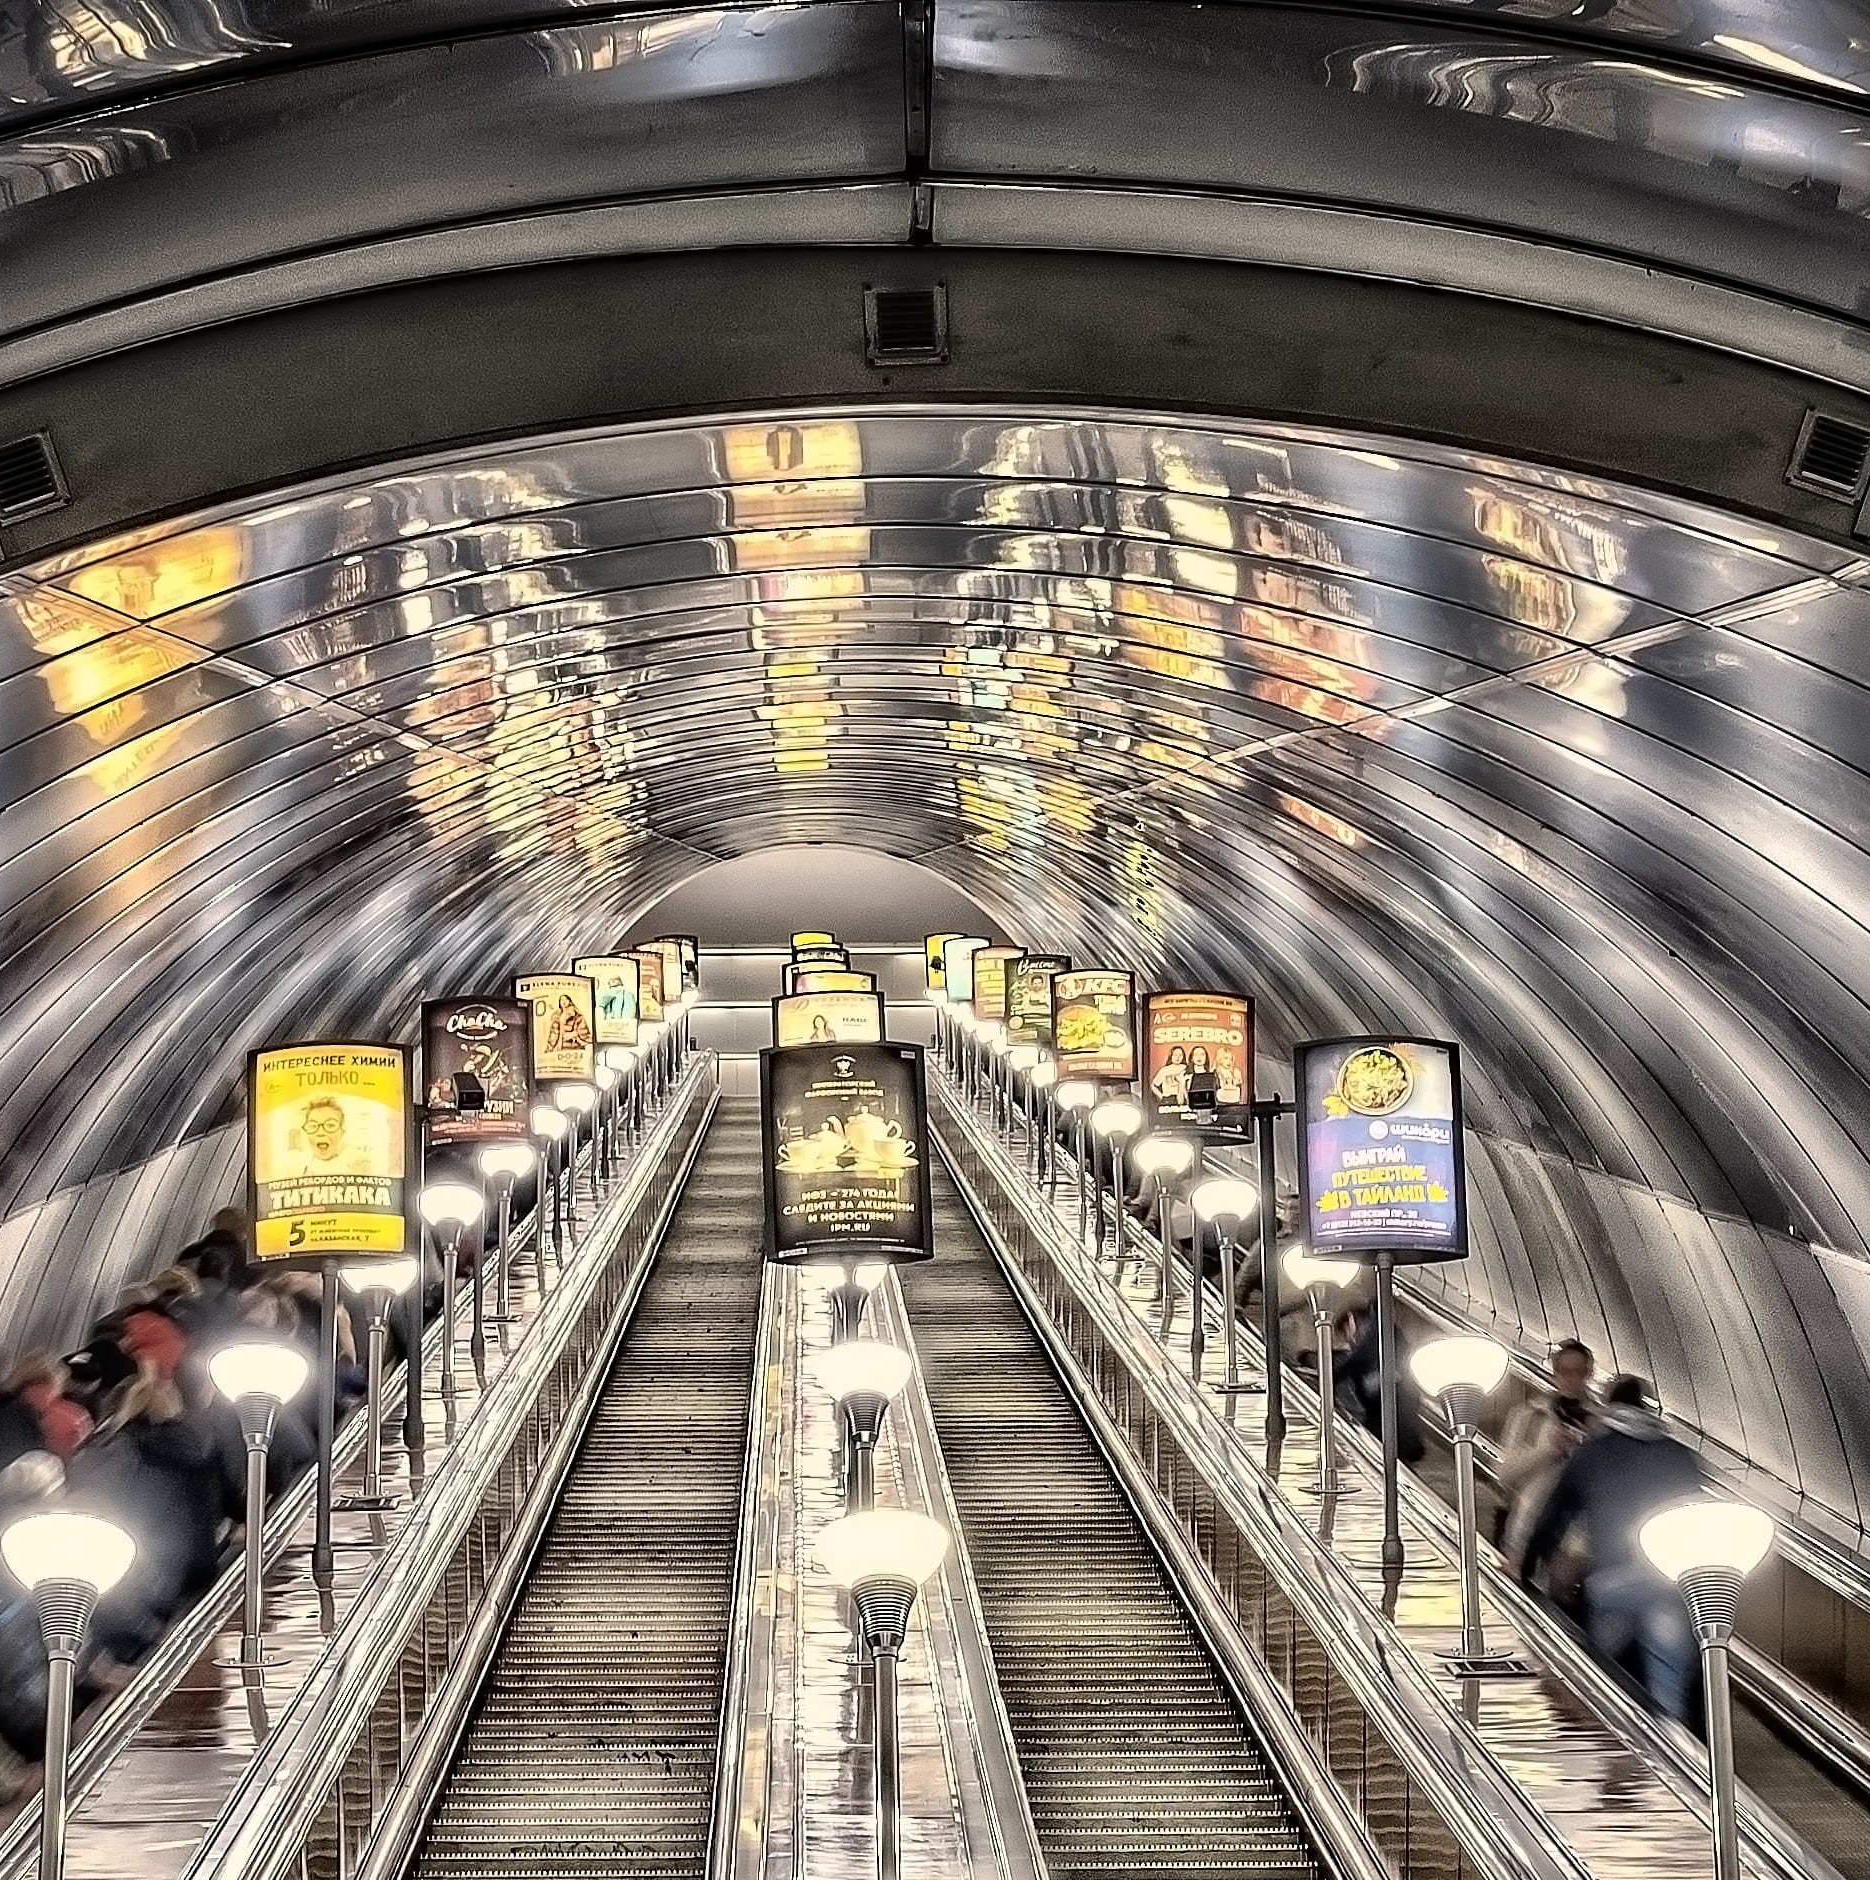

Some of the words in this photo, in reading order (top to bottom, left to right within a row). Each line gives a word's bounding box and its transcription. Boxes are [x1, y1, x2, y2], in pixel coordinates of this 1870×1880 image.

[1083, 979, 1127, 995] KFC
[1153, 1026, 1244, 1047] SEREBRO
[263, 1055, 345, 1072] ИНТЕРЕСНЕЕ
[351, 1056, 396, 1068] ХИМИИ
[295, 1071, 359, 1087] ТОЛЬКО
[1342, 1144, 1407, 1168] ВЫИГРАЙ
[298, 1175, 345, 1186] РЕКОРДОВ
[346, 1175, 355, 1185] И
[356, 1176, 393, 1186] ФАКТОВ
[1332, 1165, 1428, 1188] ПУТЕШЕСТВИЕ
[269, 1185, 392, 1209] ТИТИКАКА
[1339, 1191, 1352, 1209] В
[1353, 1184, 1426, 1206] ТАЙЛАНД
[783, 1200, 837, 1215] СЛЕДИТЕ
[839, 1200, 854, 1209] ЗА
[857, 1200, 915, 1212] АКЦИЯМИ
[807, 1213, 818, 1223] И
[820, 1211, 895, 1221] НОВОСТЯМИ
[289, 1219, 306, 1247] 5
[830, 1222, 871, 1232] IPM.RU
